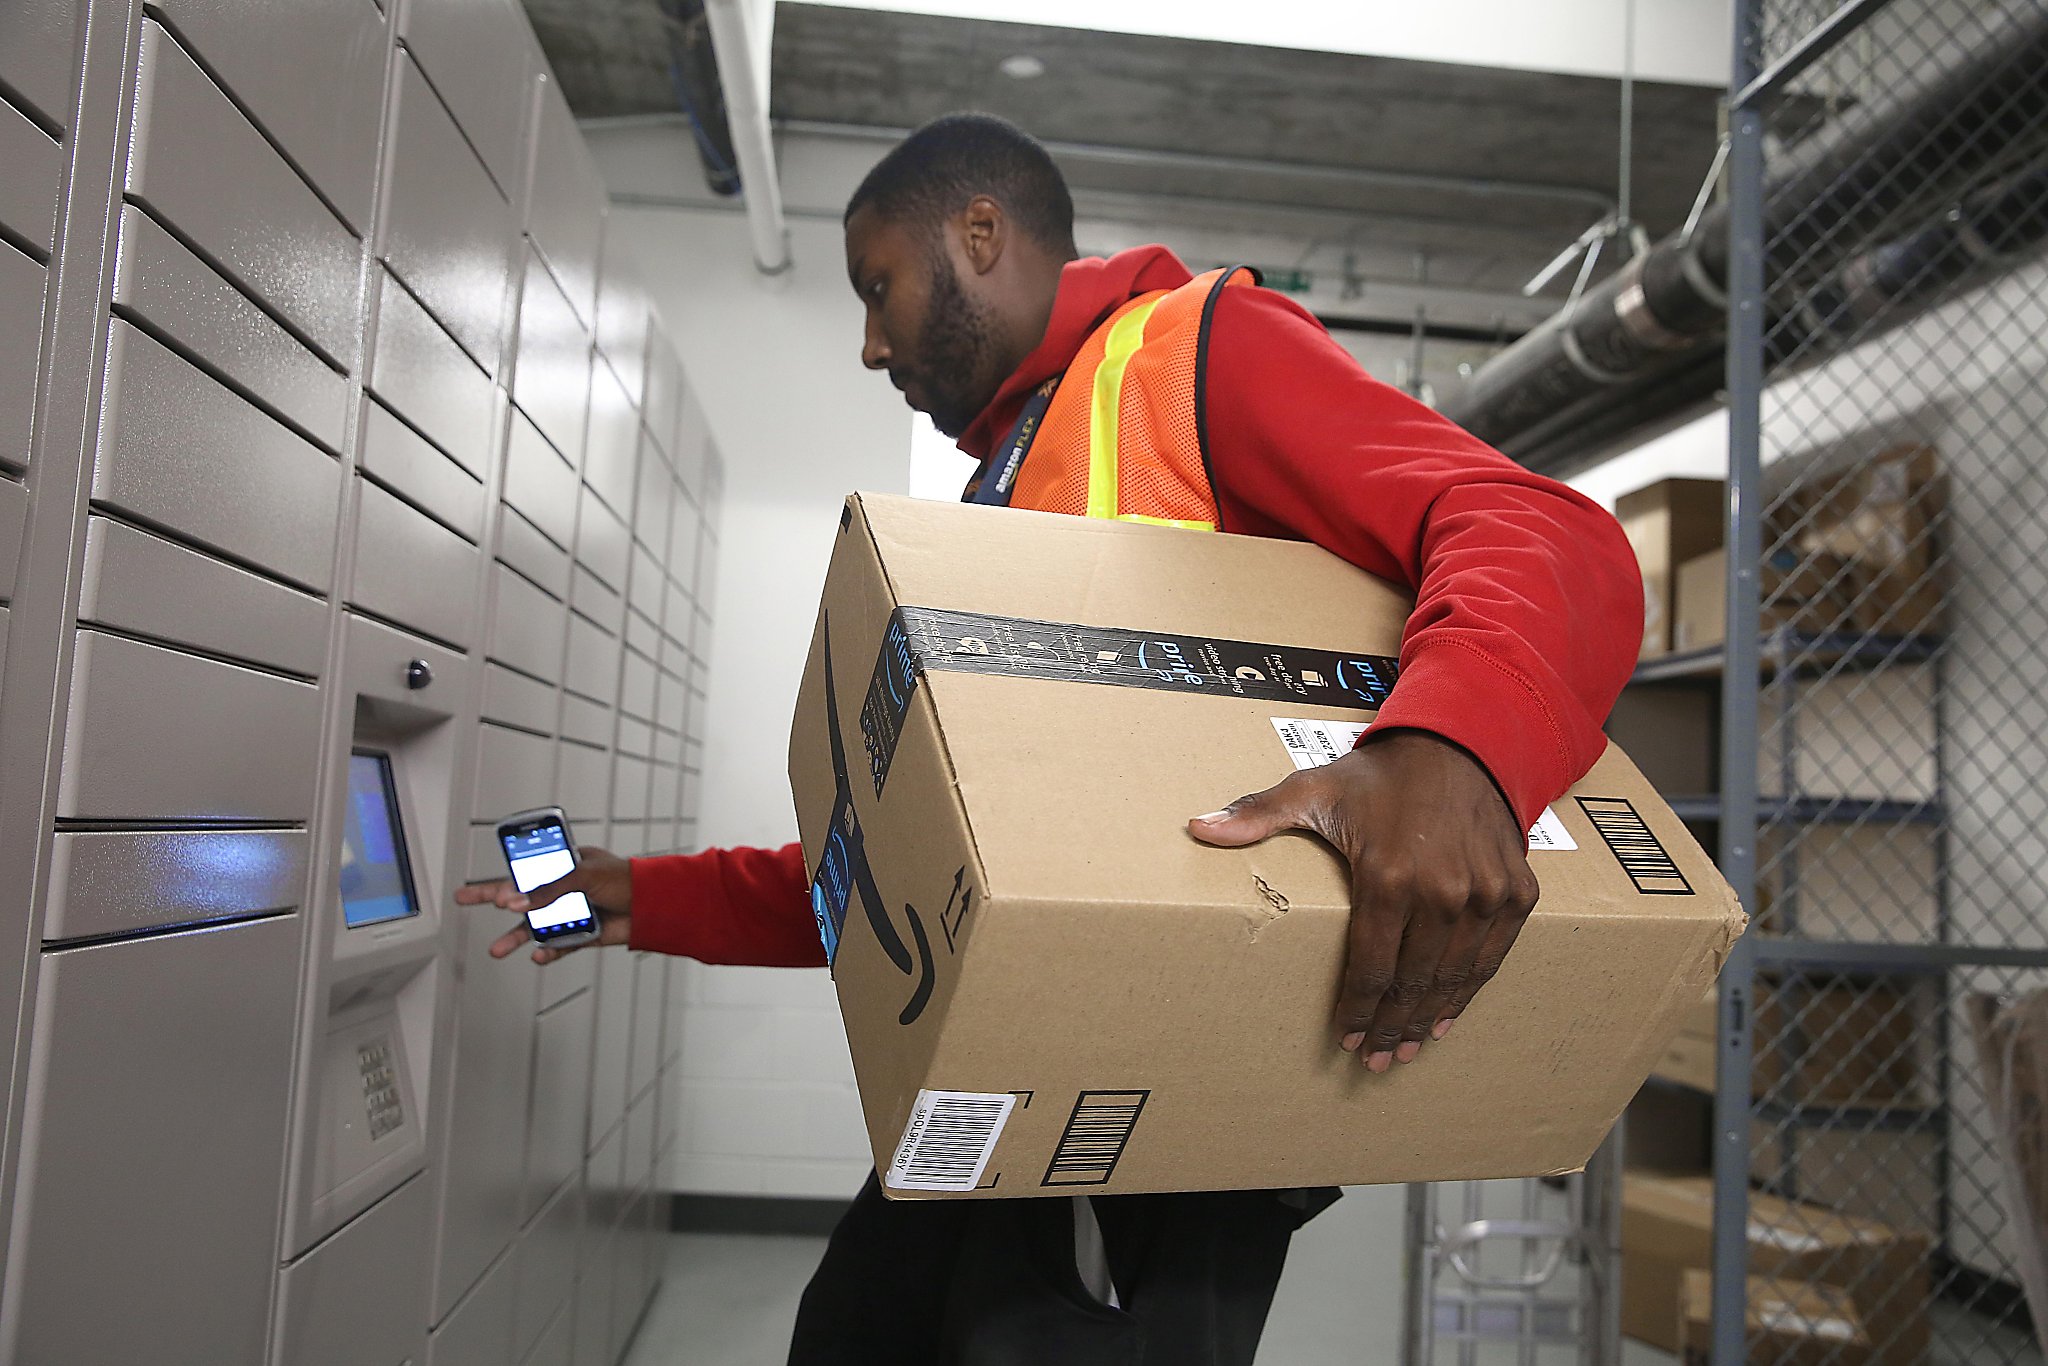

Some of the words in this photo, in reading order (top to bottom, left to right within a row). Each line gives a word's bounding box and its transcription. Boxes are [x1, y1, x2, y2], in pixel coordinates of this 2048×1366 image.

[996, 447, 1023, 493] amazon
[889, 621, 914, 689] prime
[1204, 643, 1222, 665] video
[1270, 653, 1287, 671] free
[826, 848, 847, 912] prime
